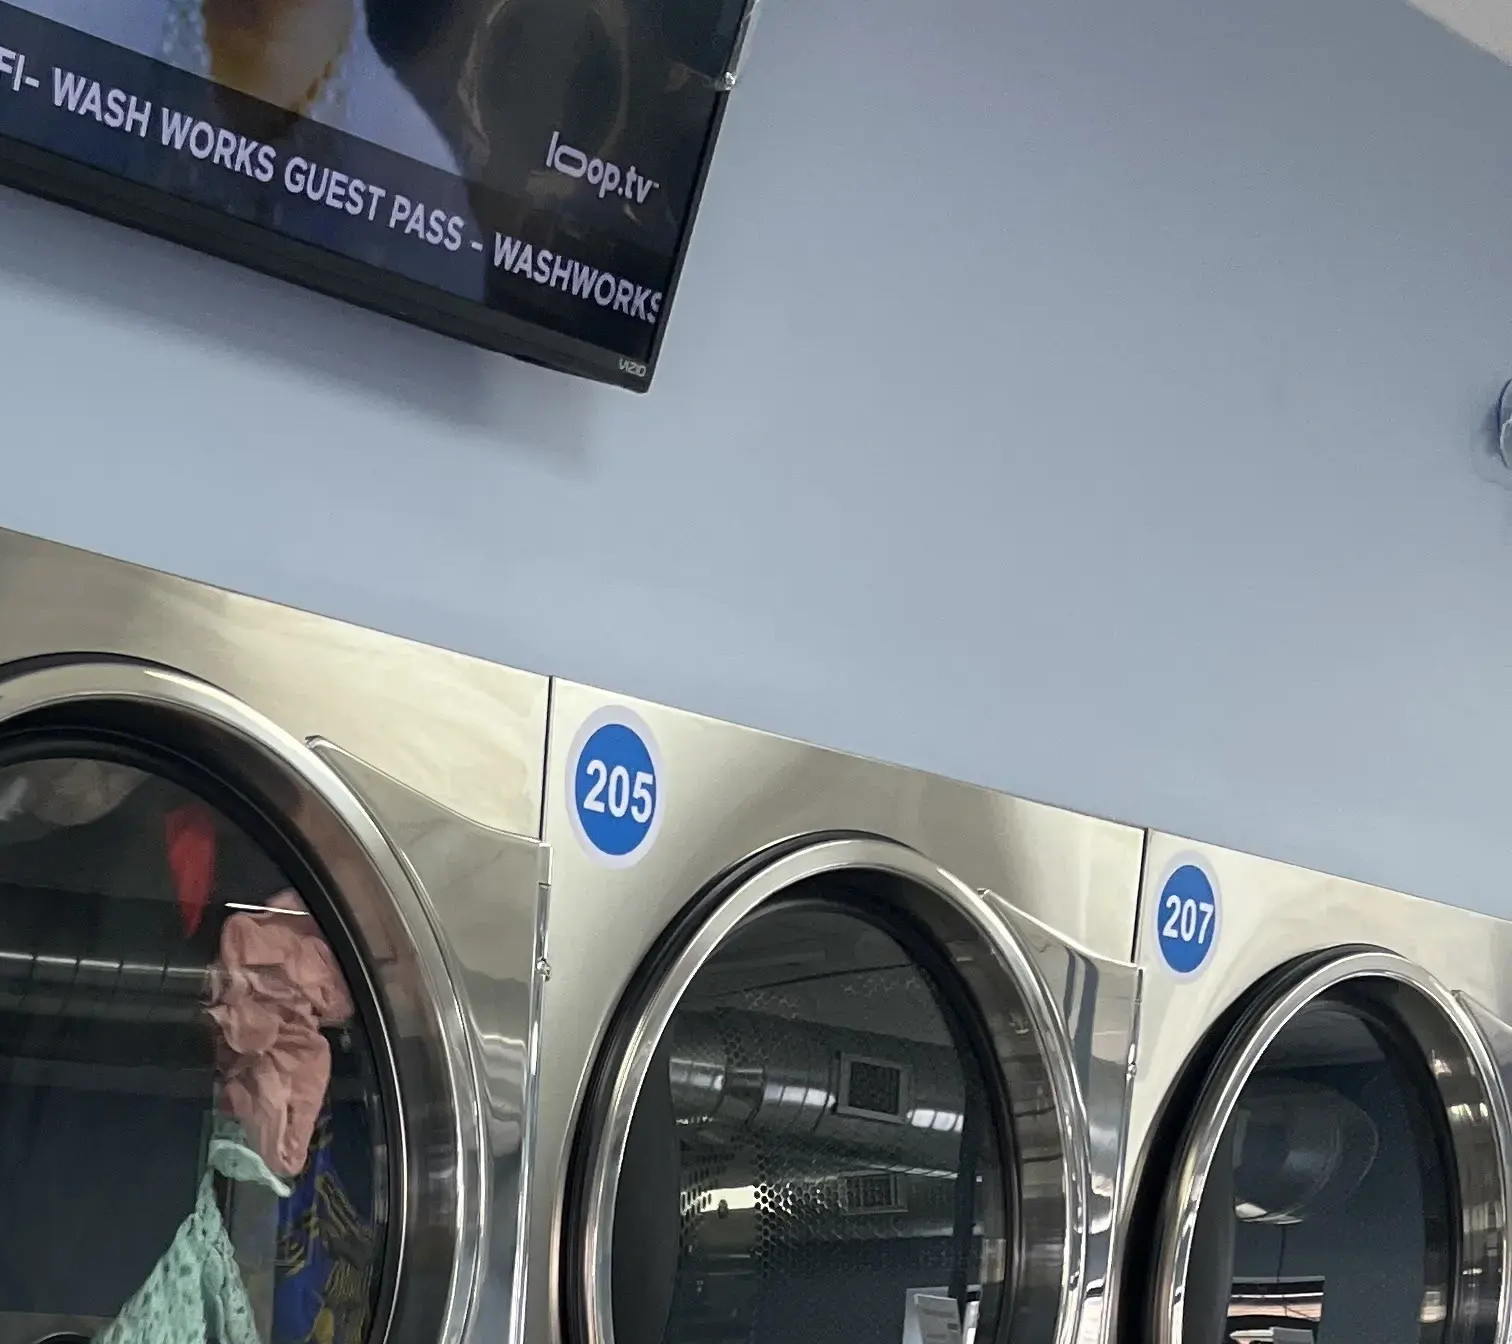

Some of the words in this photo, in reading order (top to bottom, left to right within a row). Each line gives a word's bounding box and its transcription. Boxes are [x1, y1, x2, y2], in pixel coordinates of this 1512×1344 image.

[51, 66, 152, 138] WASH
[161, 106, 277, 183] WORKS
[283, 156, 387, 222] GUEST
[389, 194, 466, 252] PASS
[493, 231, 662, 325] WASHWORKS
[618, 358, 647, 378] VIZIO
[583, 759, 654, 823] 205
[1162, 894, 1214, 945] 207
